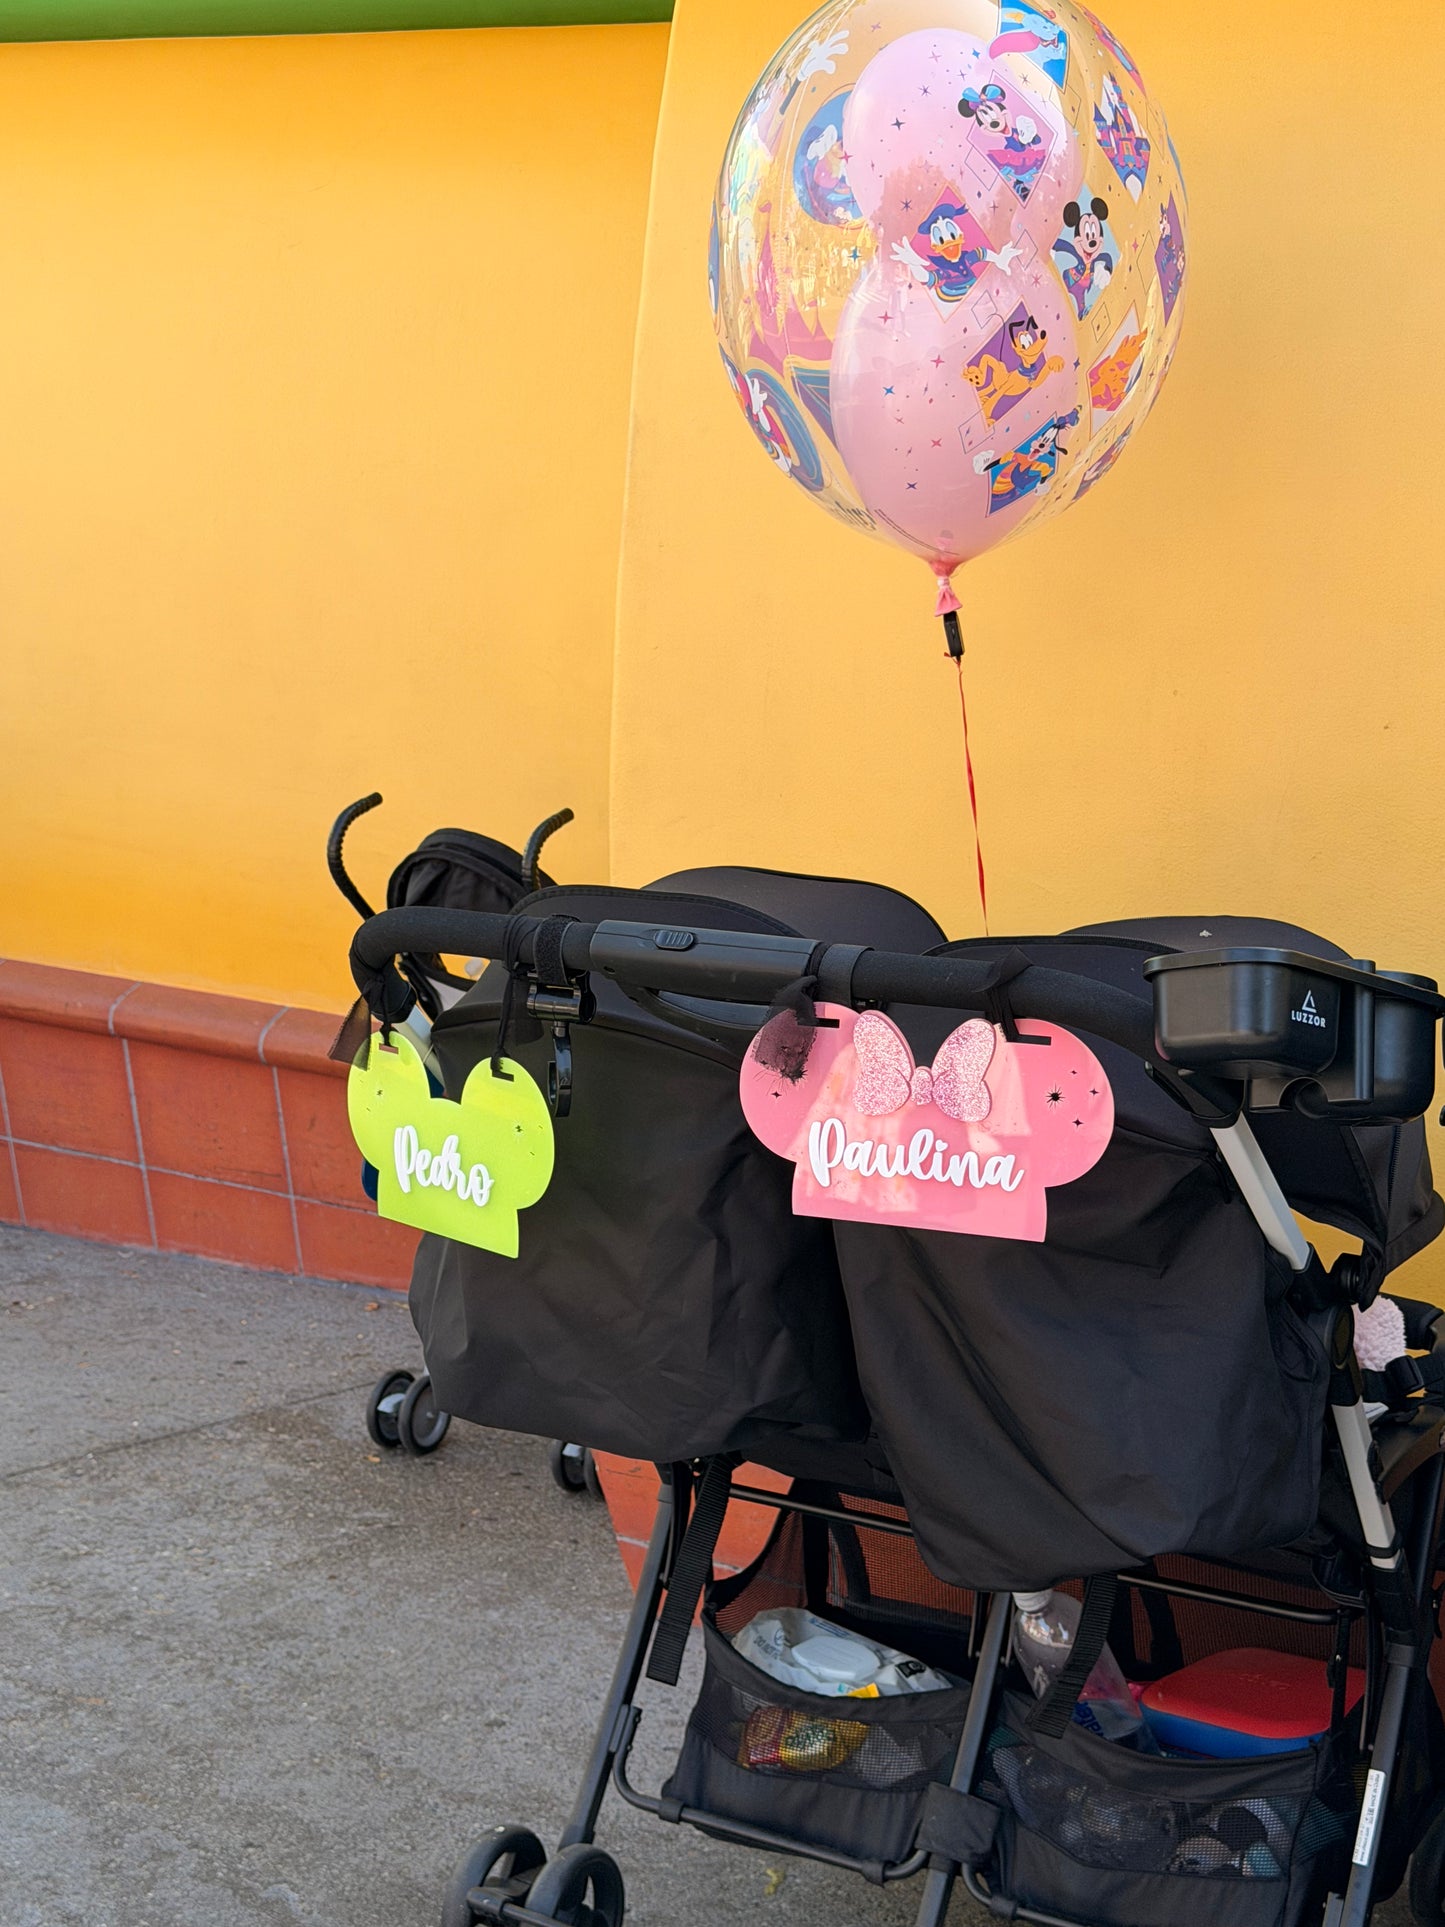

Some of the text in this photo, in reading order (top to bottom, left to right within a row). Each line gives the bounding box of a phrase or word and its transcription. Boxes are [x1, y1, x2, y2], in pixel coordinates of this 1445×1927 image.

[1291, 1010, 1326, 1028] LUZZOR
[393, 1124, 495, 1208] Pedro
[808, 1117, 1025, 1193] Paulina
